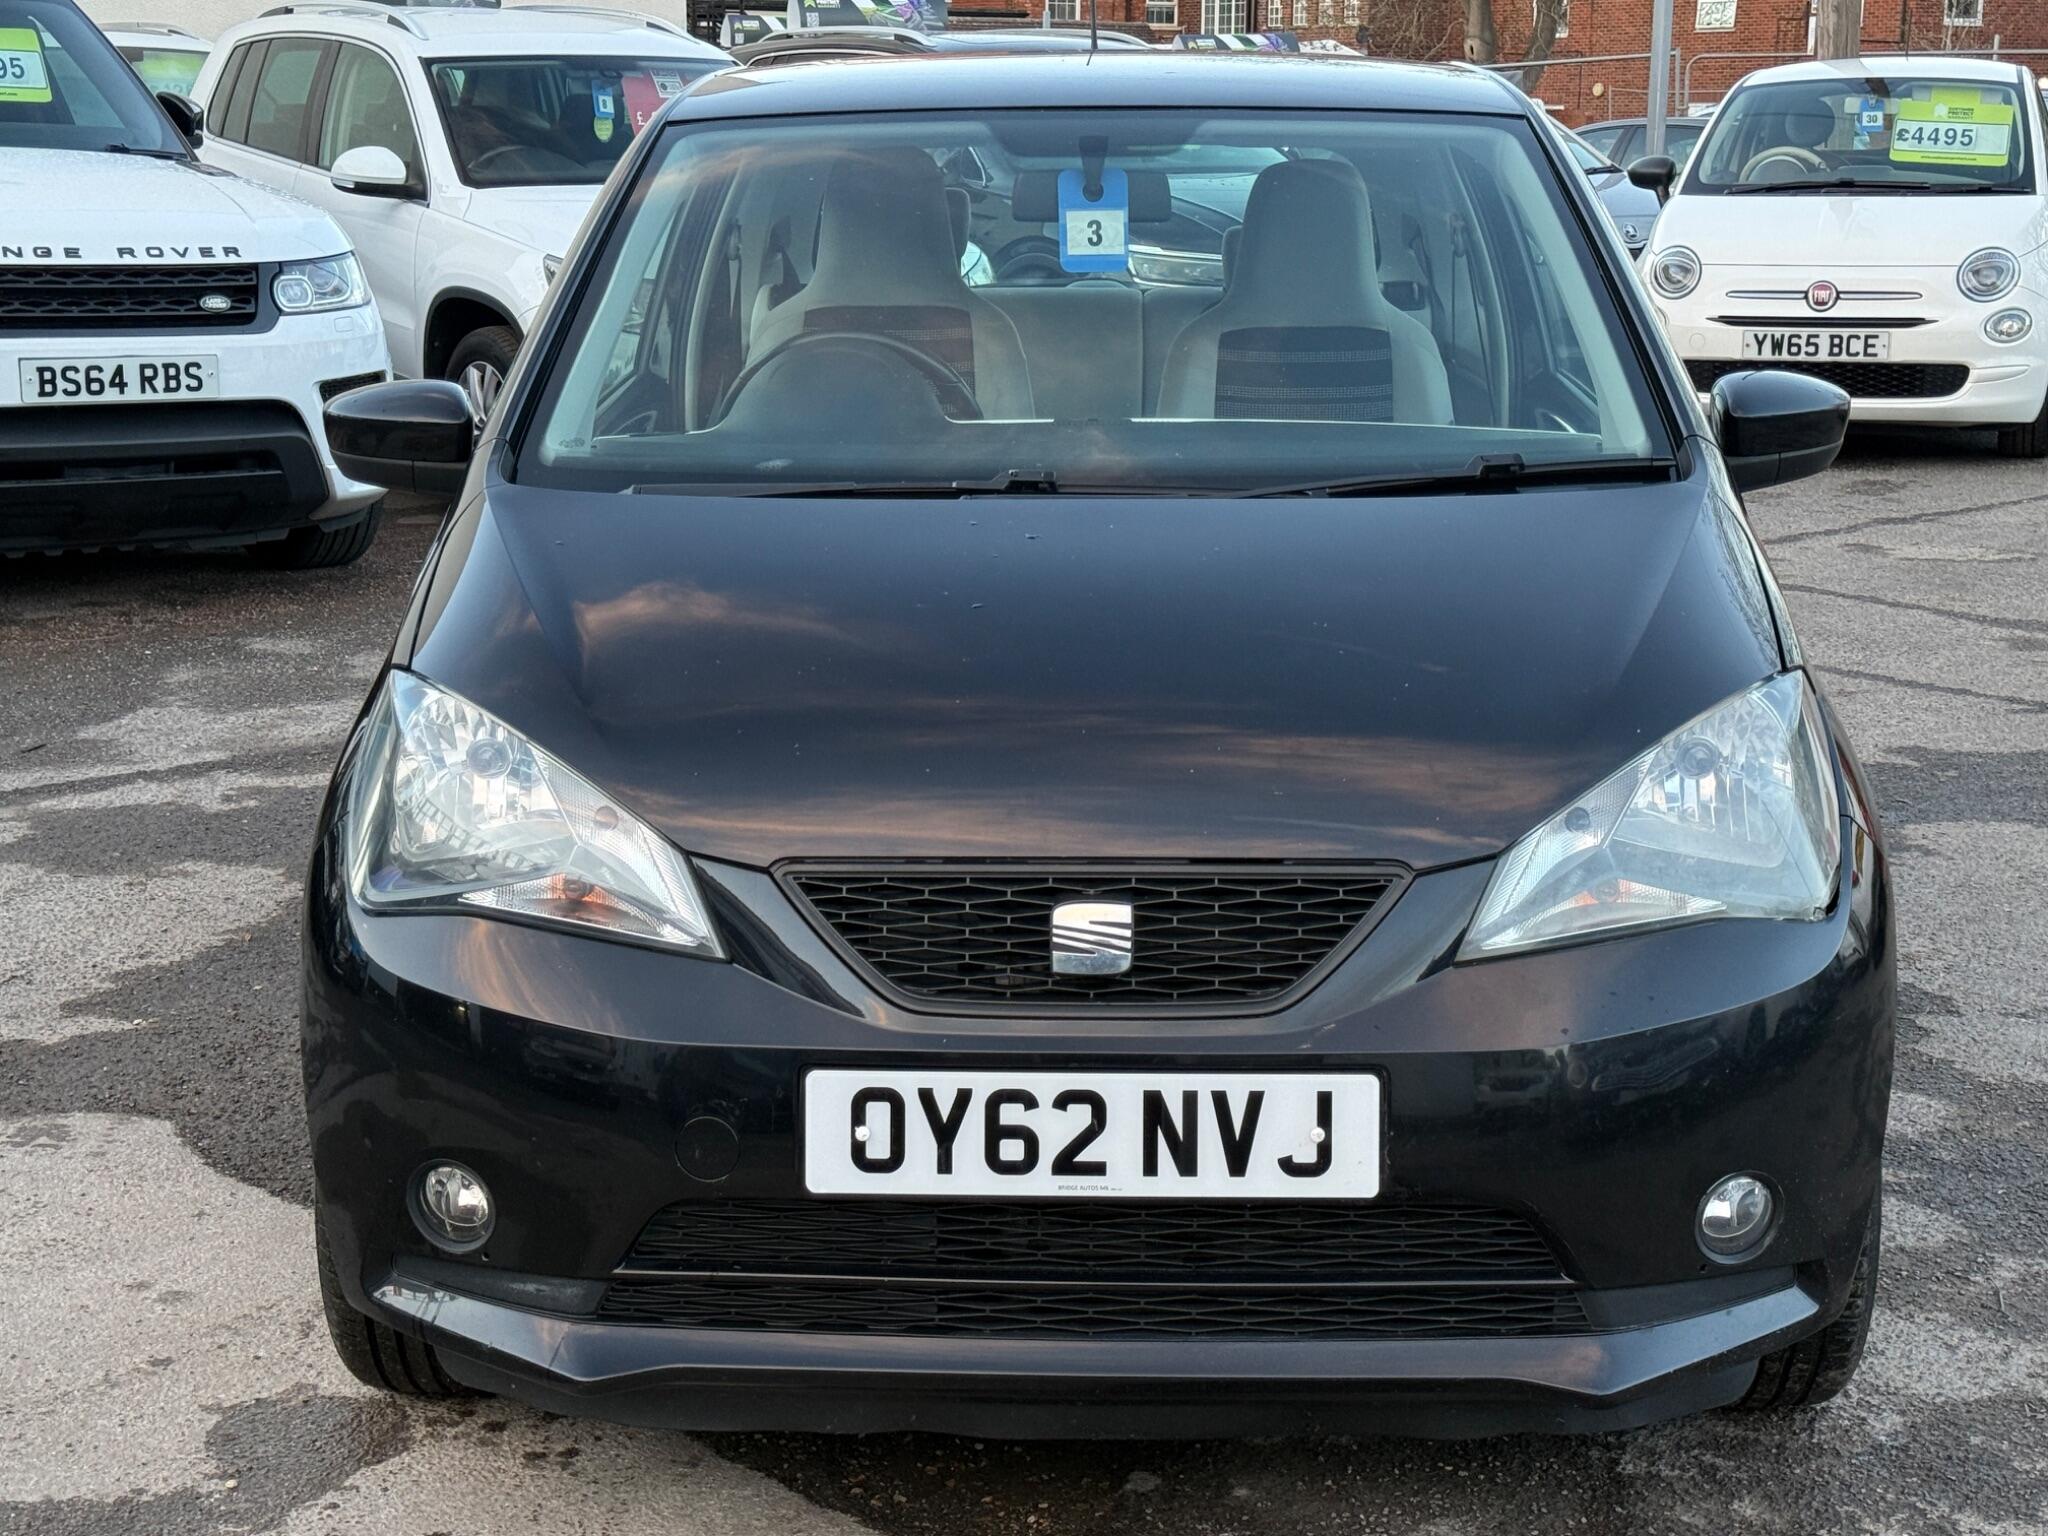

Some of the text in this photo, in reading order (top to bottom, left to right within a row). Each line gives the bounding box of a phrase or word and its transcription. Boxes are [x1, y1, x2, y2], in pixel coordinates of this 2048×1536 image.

[1866, 114, 1877, 123] 30
[1896, 127, 1974, 147] £4495
[1087, 219, 1103, 247] 3
[116, 246, 242, 258] ROVER
[1814, 290, 1830, 302] FIAT
[1753, 333, 1879, 357] YW65 BCE
[36, 362, 203, 397] BS64 RBS
[851, 1086, 1333, 1177] OY62 NVJ
